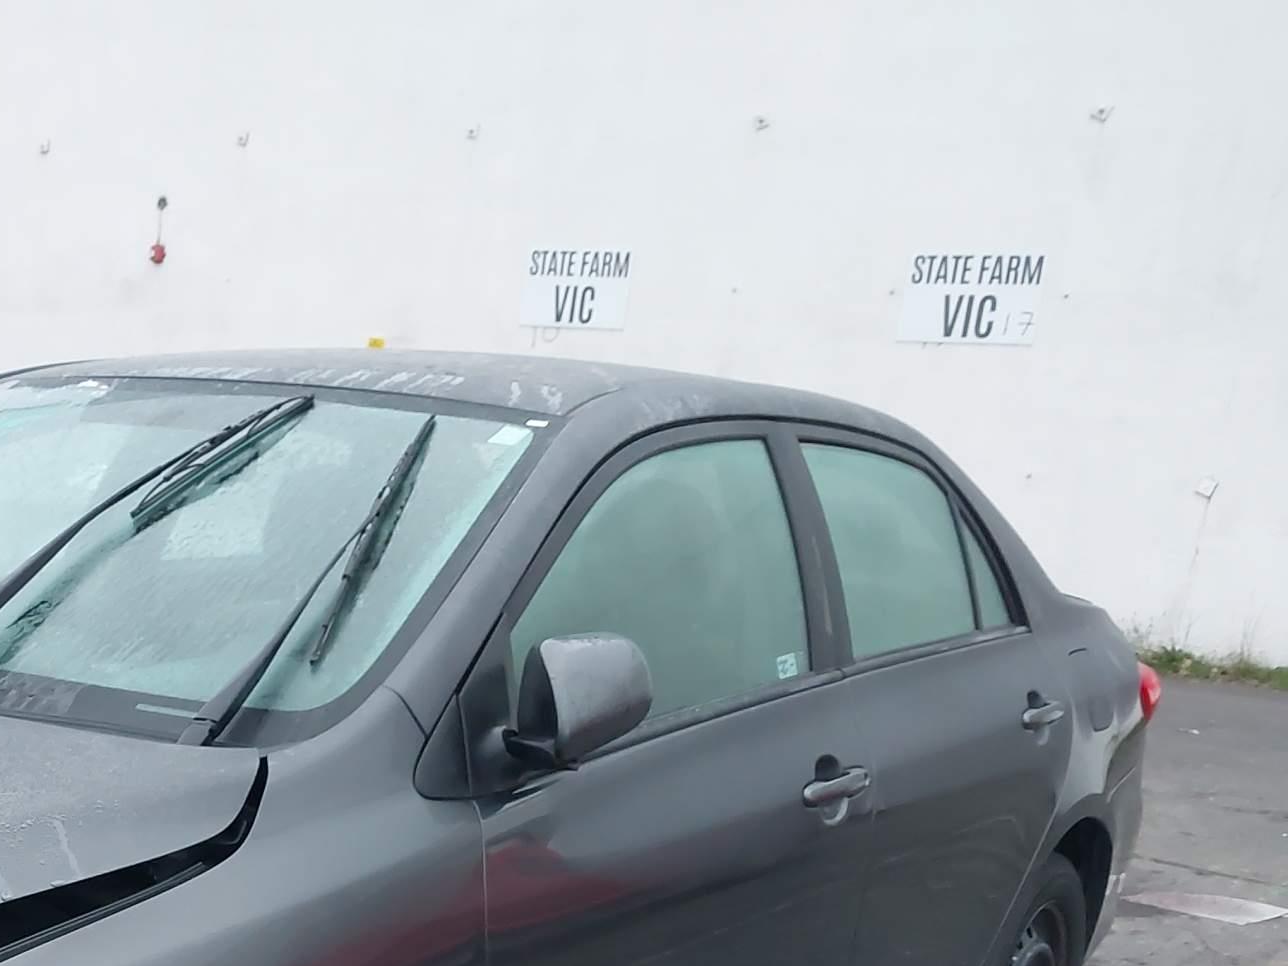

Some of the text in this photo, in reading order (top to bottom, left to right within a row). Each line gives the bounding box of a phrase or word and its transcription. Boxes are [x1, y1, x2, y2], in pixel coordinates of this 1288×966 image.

[529, 249, 631, 278] STATE FARM
[911, 254, 1045, 286] STATE FARM
[554, 284, 595, 324] VIC
[943, 293, 998, 339] VIC
[1002, 311, 1035, 337] 17
